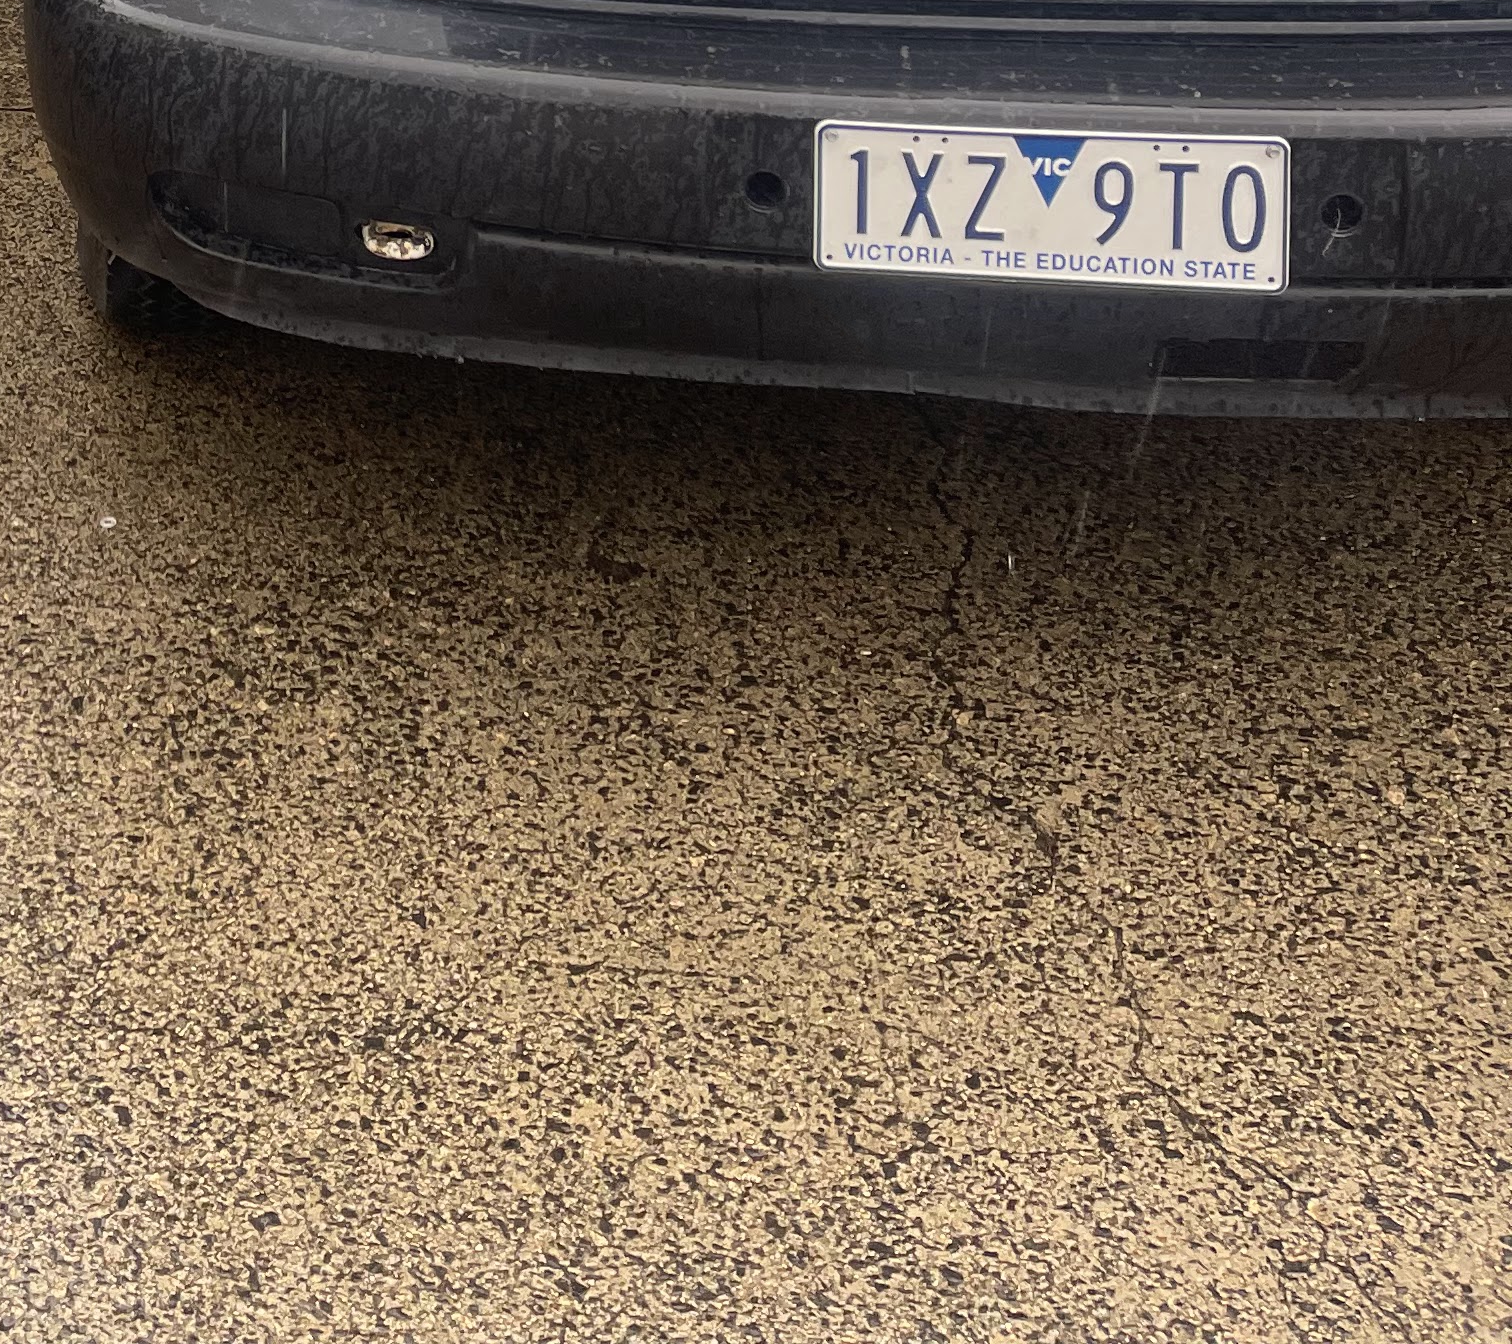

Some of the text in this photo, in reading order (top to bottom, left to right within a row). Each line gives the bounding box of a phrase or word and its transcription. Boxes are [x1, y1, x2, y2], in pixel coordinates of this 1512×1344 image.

[1025, 155, 1071, 177] VIC
[849, 148, 1007, 242] 1XZ
[844, 243, 954, 265] VICTORIA
[982, 250, 1027, 269] THE
[1036, 253, 1175, 277] EDUCATION
[1184, 260, 1257, 281] STATE
